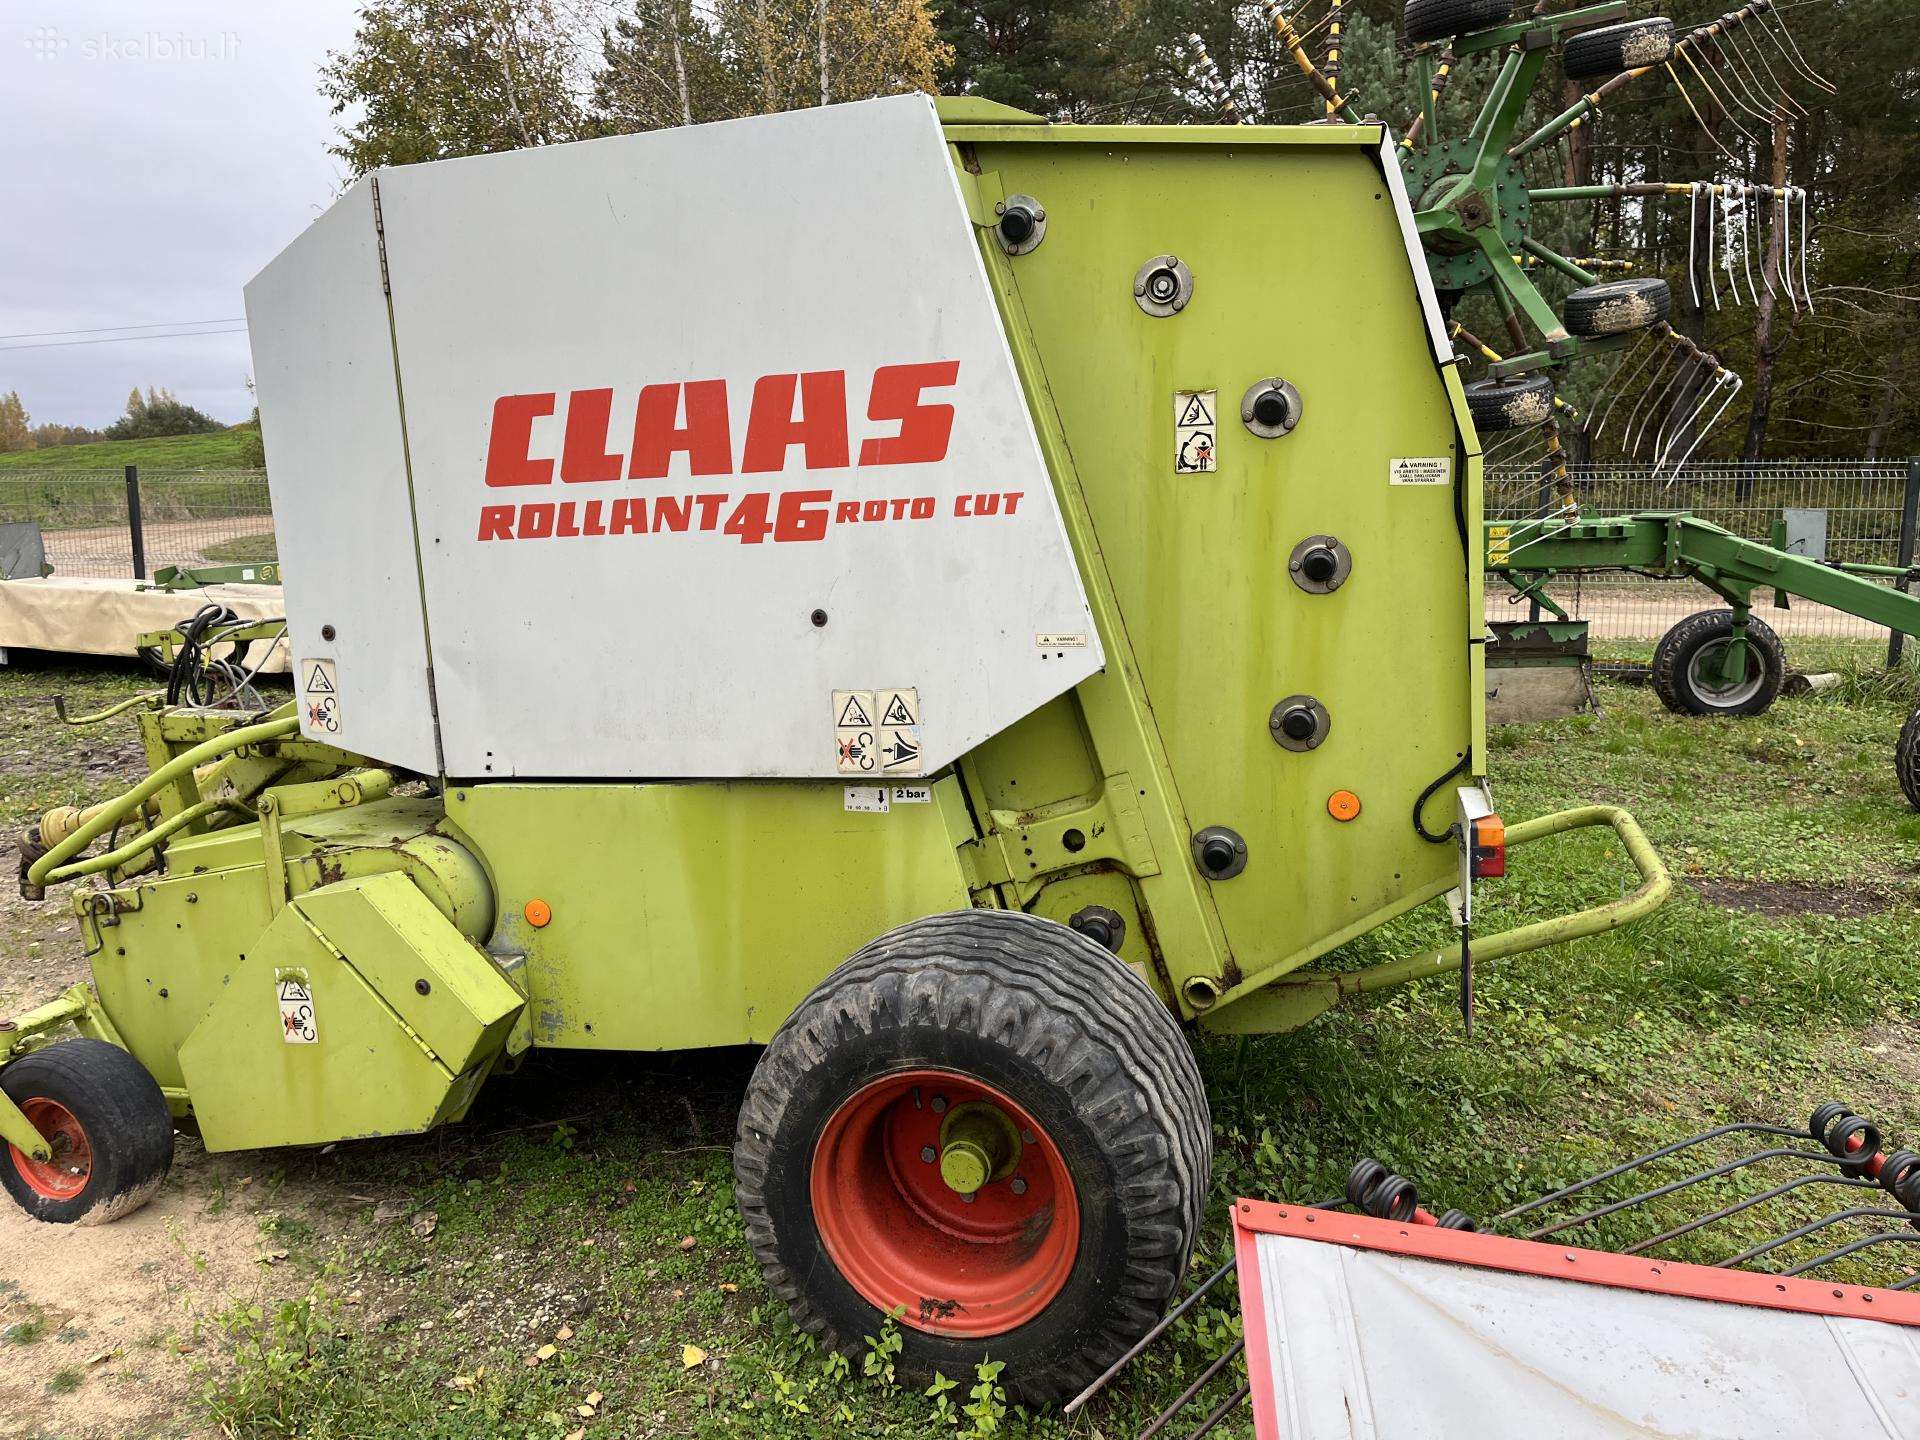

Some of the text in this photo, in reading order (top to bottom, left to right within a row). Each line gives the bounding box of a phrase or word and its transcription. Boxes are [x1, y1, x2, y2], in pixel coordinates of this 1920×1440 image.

[485, 361, 960, 488] CLAAS
[836, 497, 936, 523] ROTO
[955, 493, 1024, 517] CUT
[896, 789, 926, 798] 2 bar
